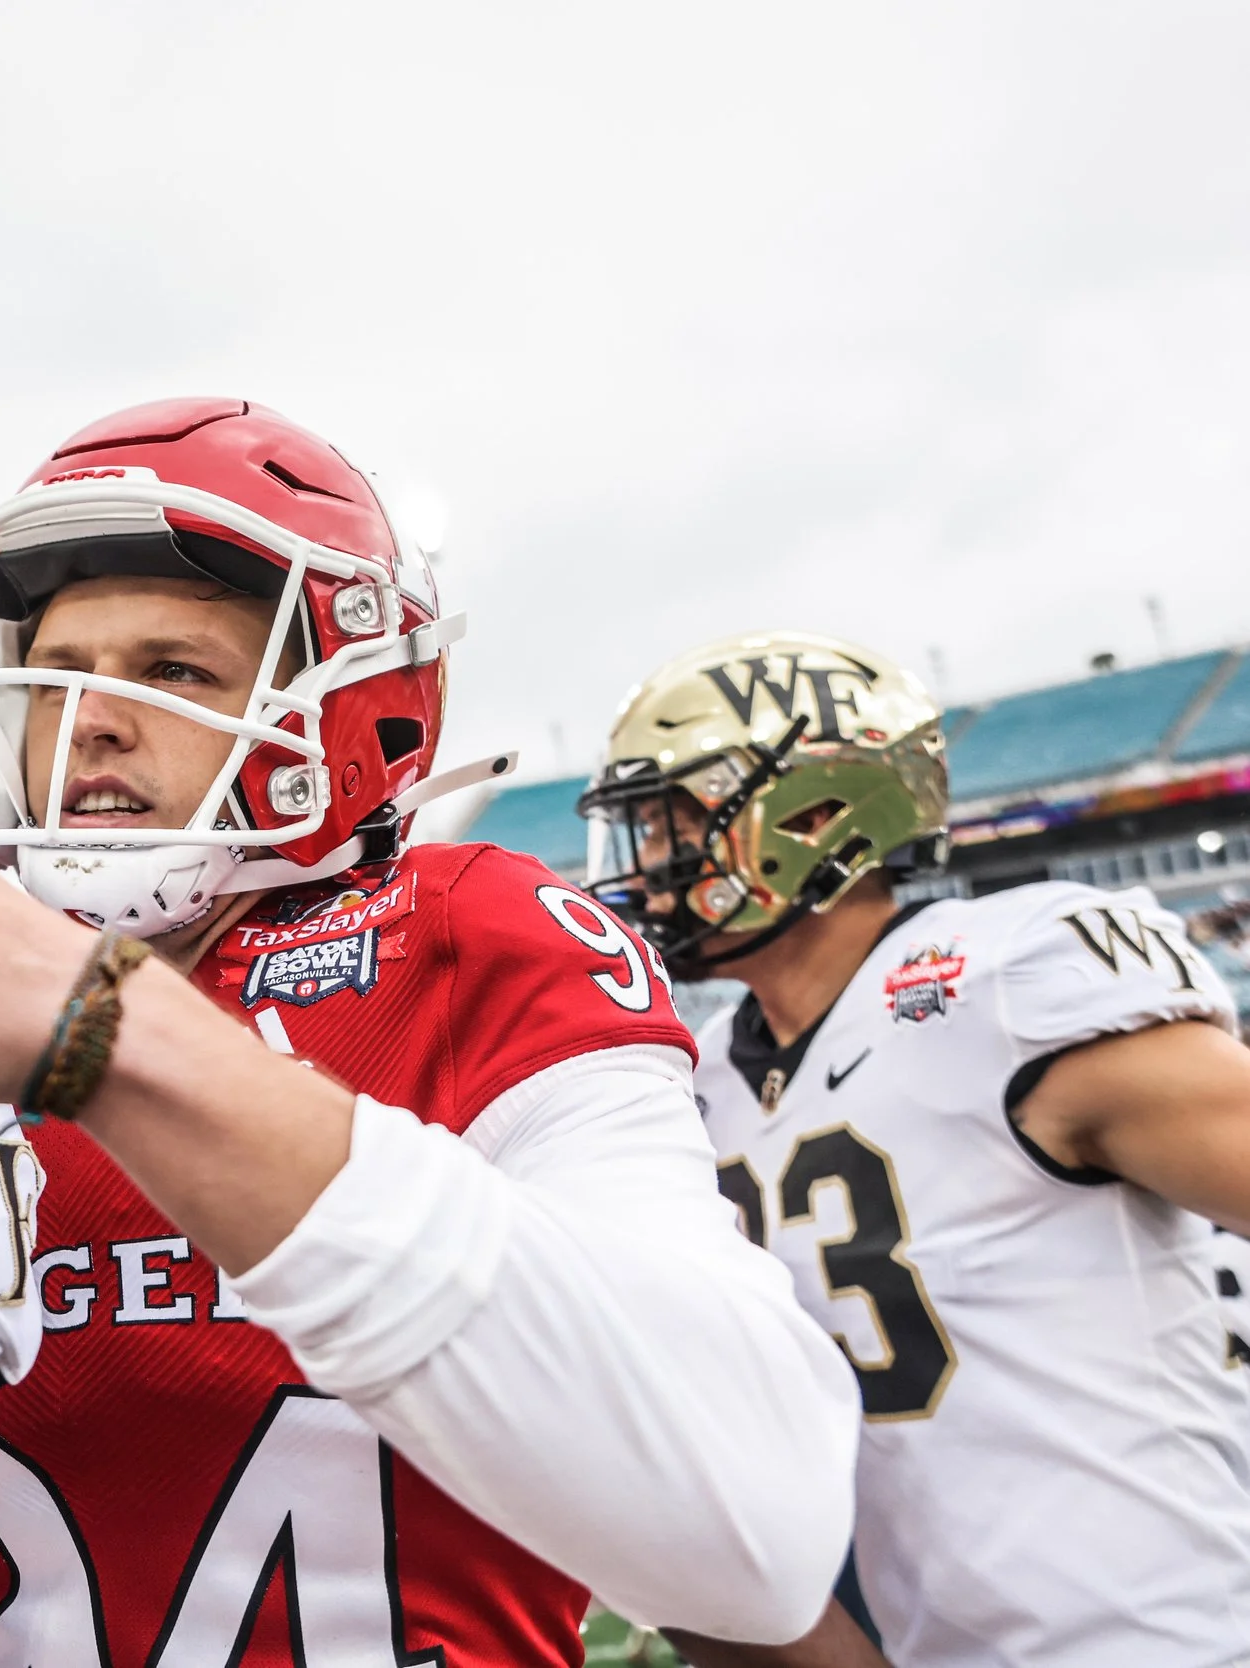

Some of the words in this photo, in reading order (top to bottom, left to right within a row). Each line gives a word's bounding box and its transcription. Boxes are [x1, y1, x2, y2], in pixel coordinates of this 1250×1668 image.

[699, 653, 872, 743] WF
[237, 886, 404, 948] TaxSlayer
[264, 951, 358, 979] BOWL
[269, 937, 359, 965] GATOR
[263, 968, 340, 986] JACKSONVILLE,
[341, 967, 353, 976] FL
